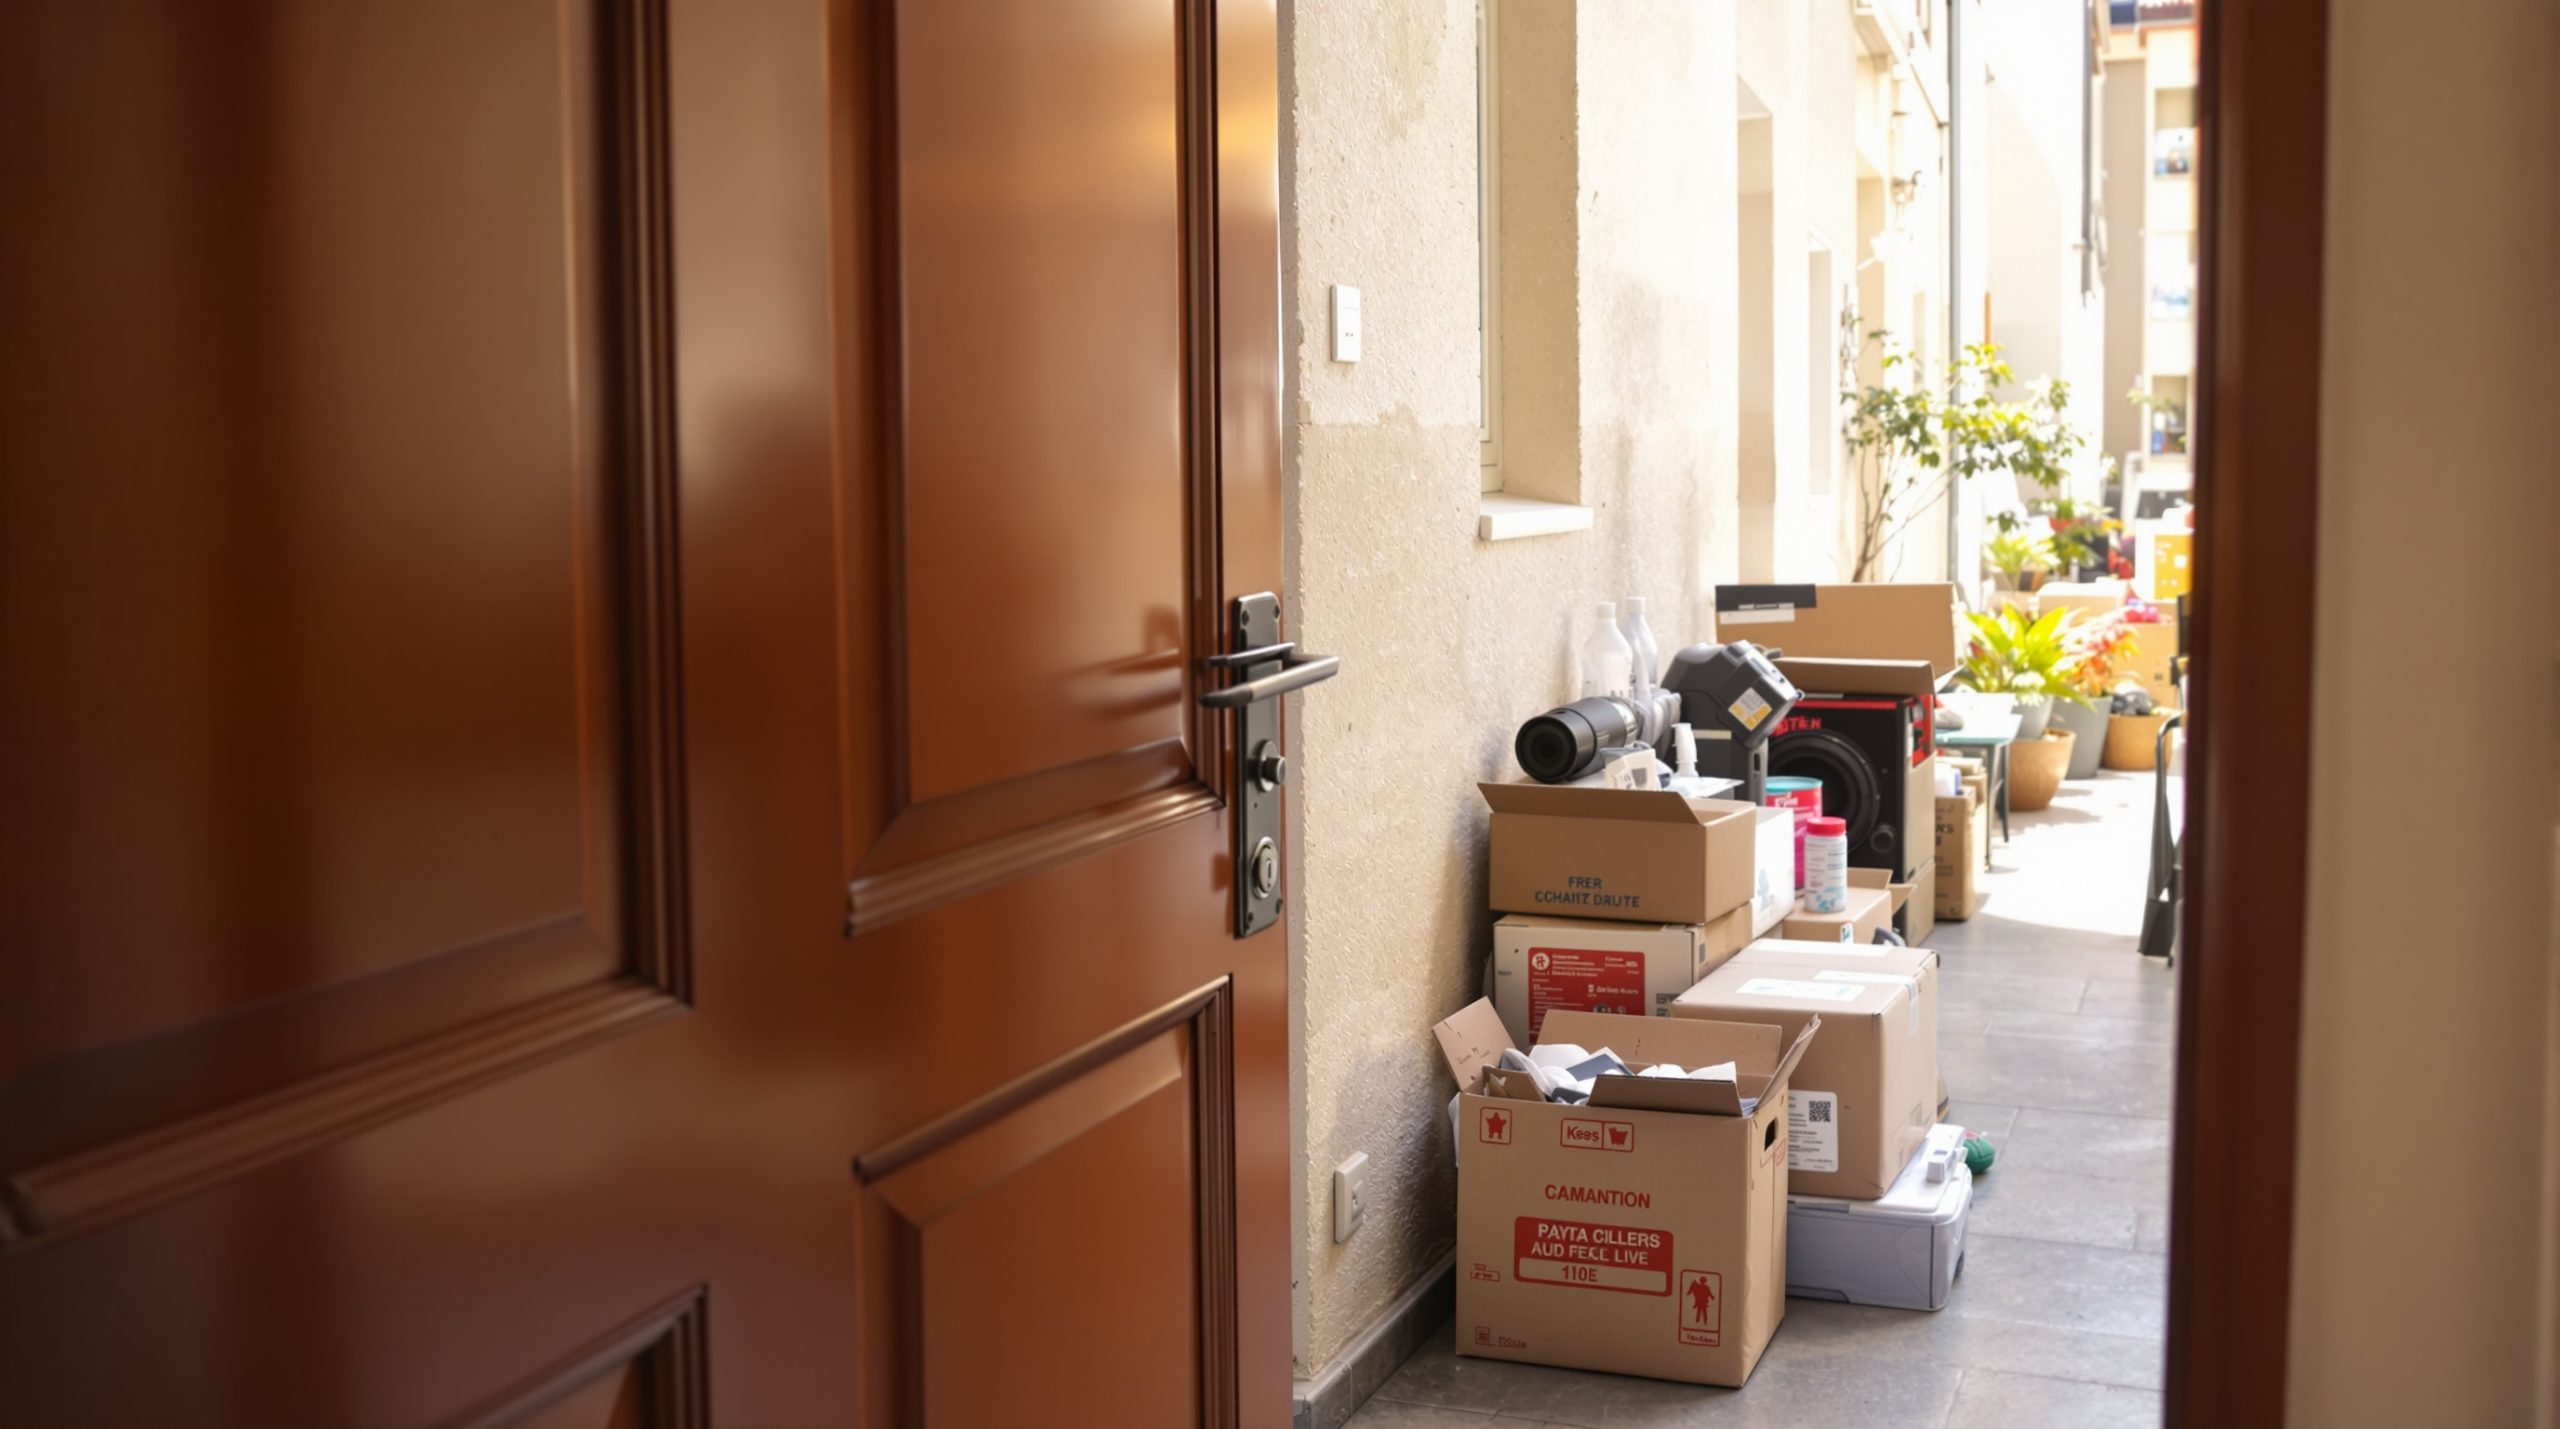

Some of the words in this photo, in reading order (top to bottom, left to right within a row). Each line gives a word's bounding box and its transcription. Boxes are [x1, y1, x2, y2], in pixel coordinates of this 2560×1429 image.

[1544, 1184, 1651, 1209] CAMANTION
[1537, 1223, 1589, 1243] PAYTA
[1592, 1228, 1662, 1248] CILLERS
[1531, 1241, 1565, 1258] AUD
[1613, 1249, 1650, 1265] LIVE
